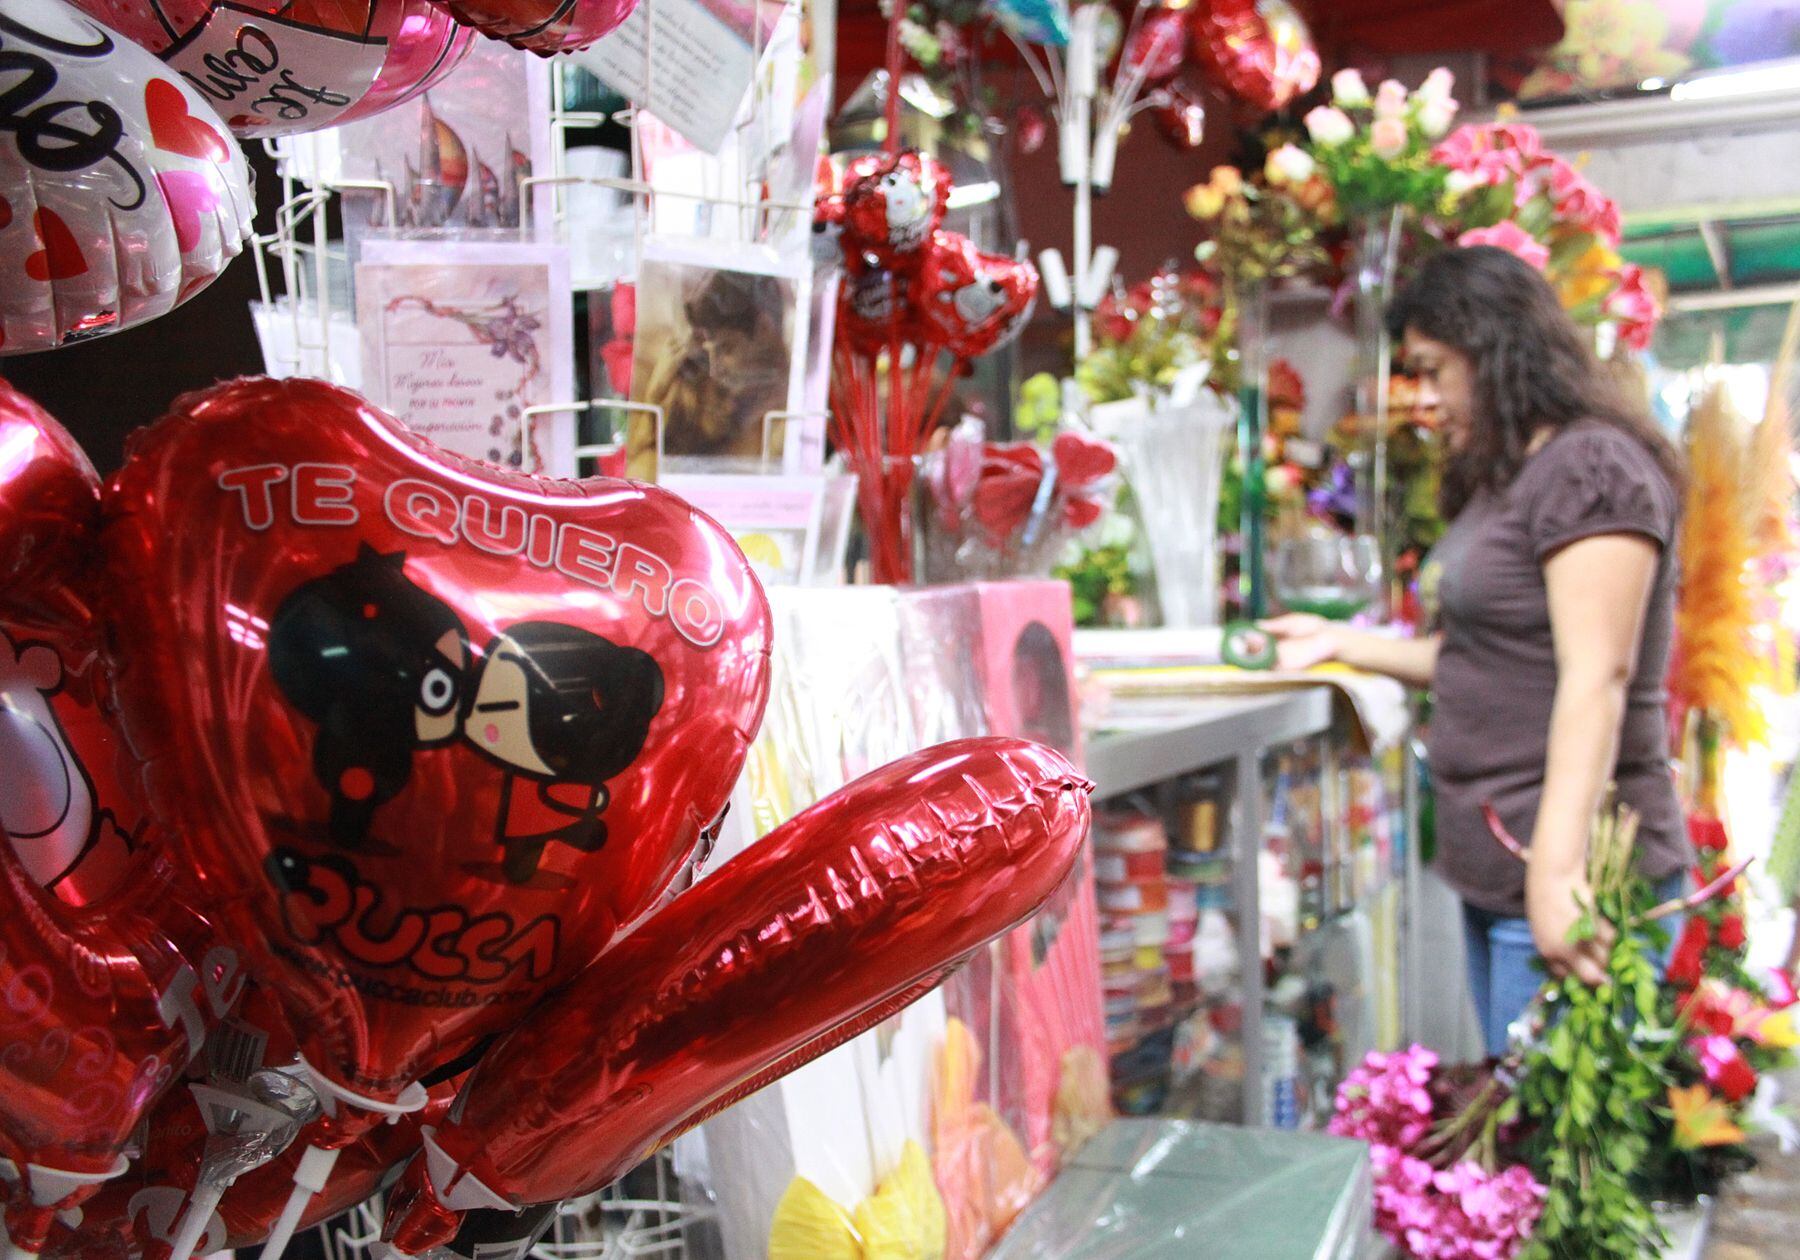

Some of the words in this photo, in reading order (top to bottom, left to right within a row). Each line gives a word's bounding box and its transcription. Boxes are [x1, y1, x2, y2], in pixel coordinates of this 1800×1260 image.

[218, 462, 360, 531] TE
[383, 478, 726, 647] QUIERO
[266, 848, 562, 984] PUCCA
